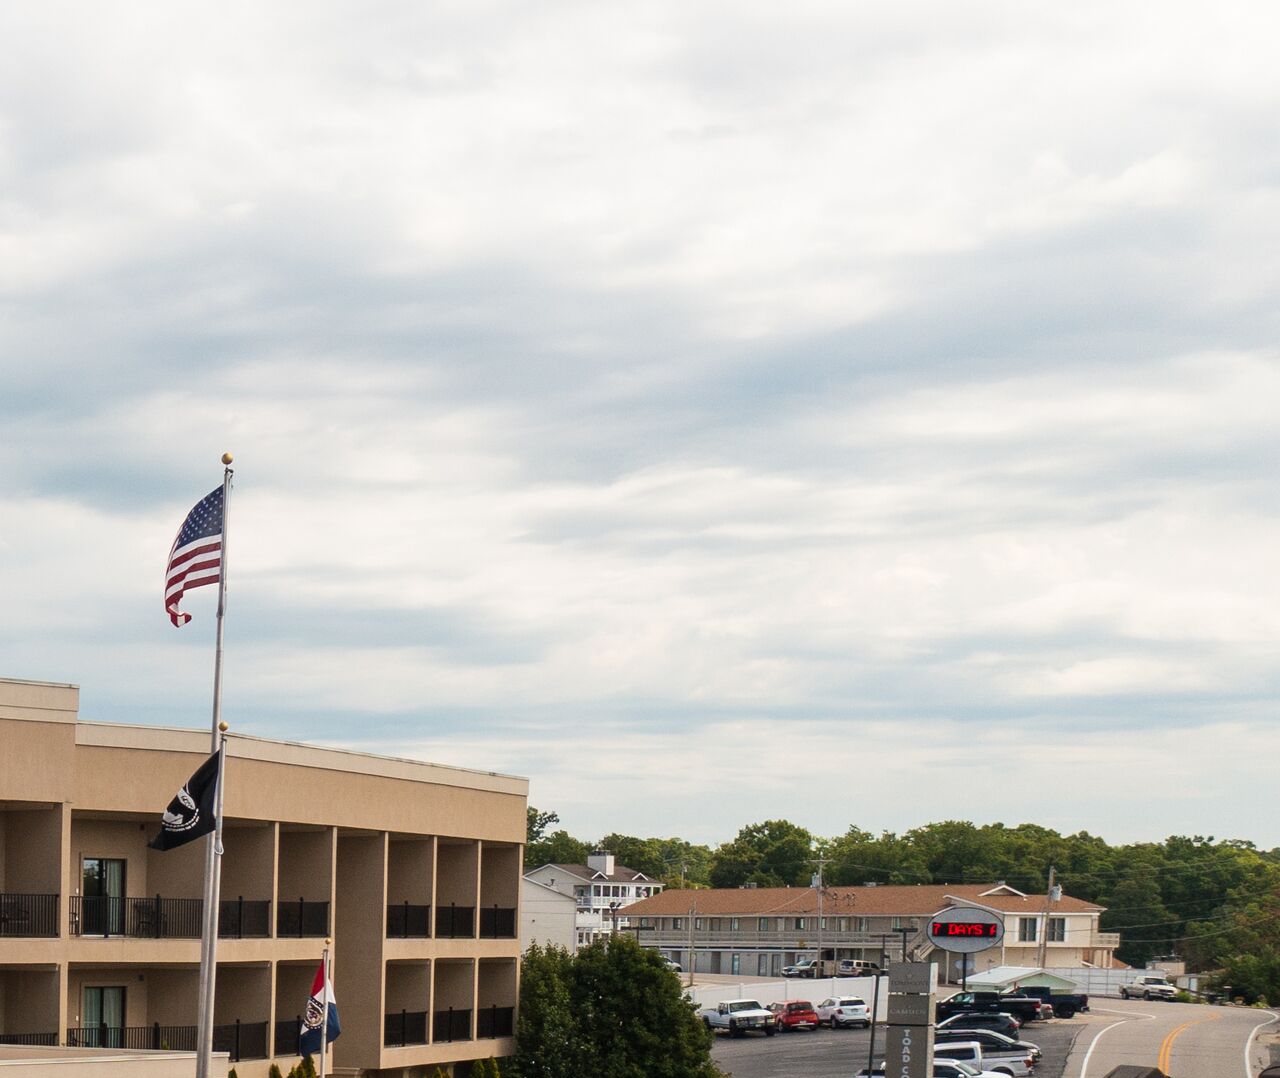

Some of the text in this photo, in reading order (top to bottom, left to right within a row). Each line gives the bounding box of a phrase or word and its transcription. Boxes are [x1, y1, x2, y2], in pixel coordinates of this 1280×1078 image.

[933, 923, 942, 936] 7
[948, 923, 983, 936] DAYS
[902, 1029, 912, 1063] TOAD
